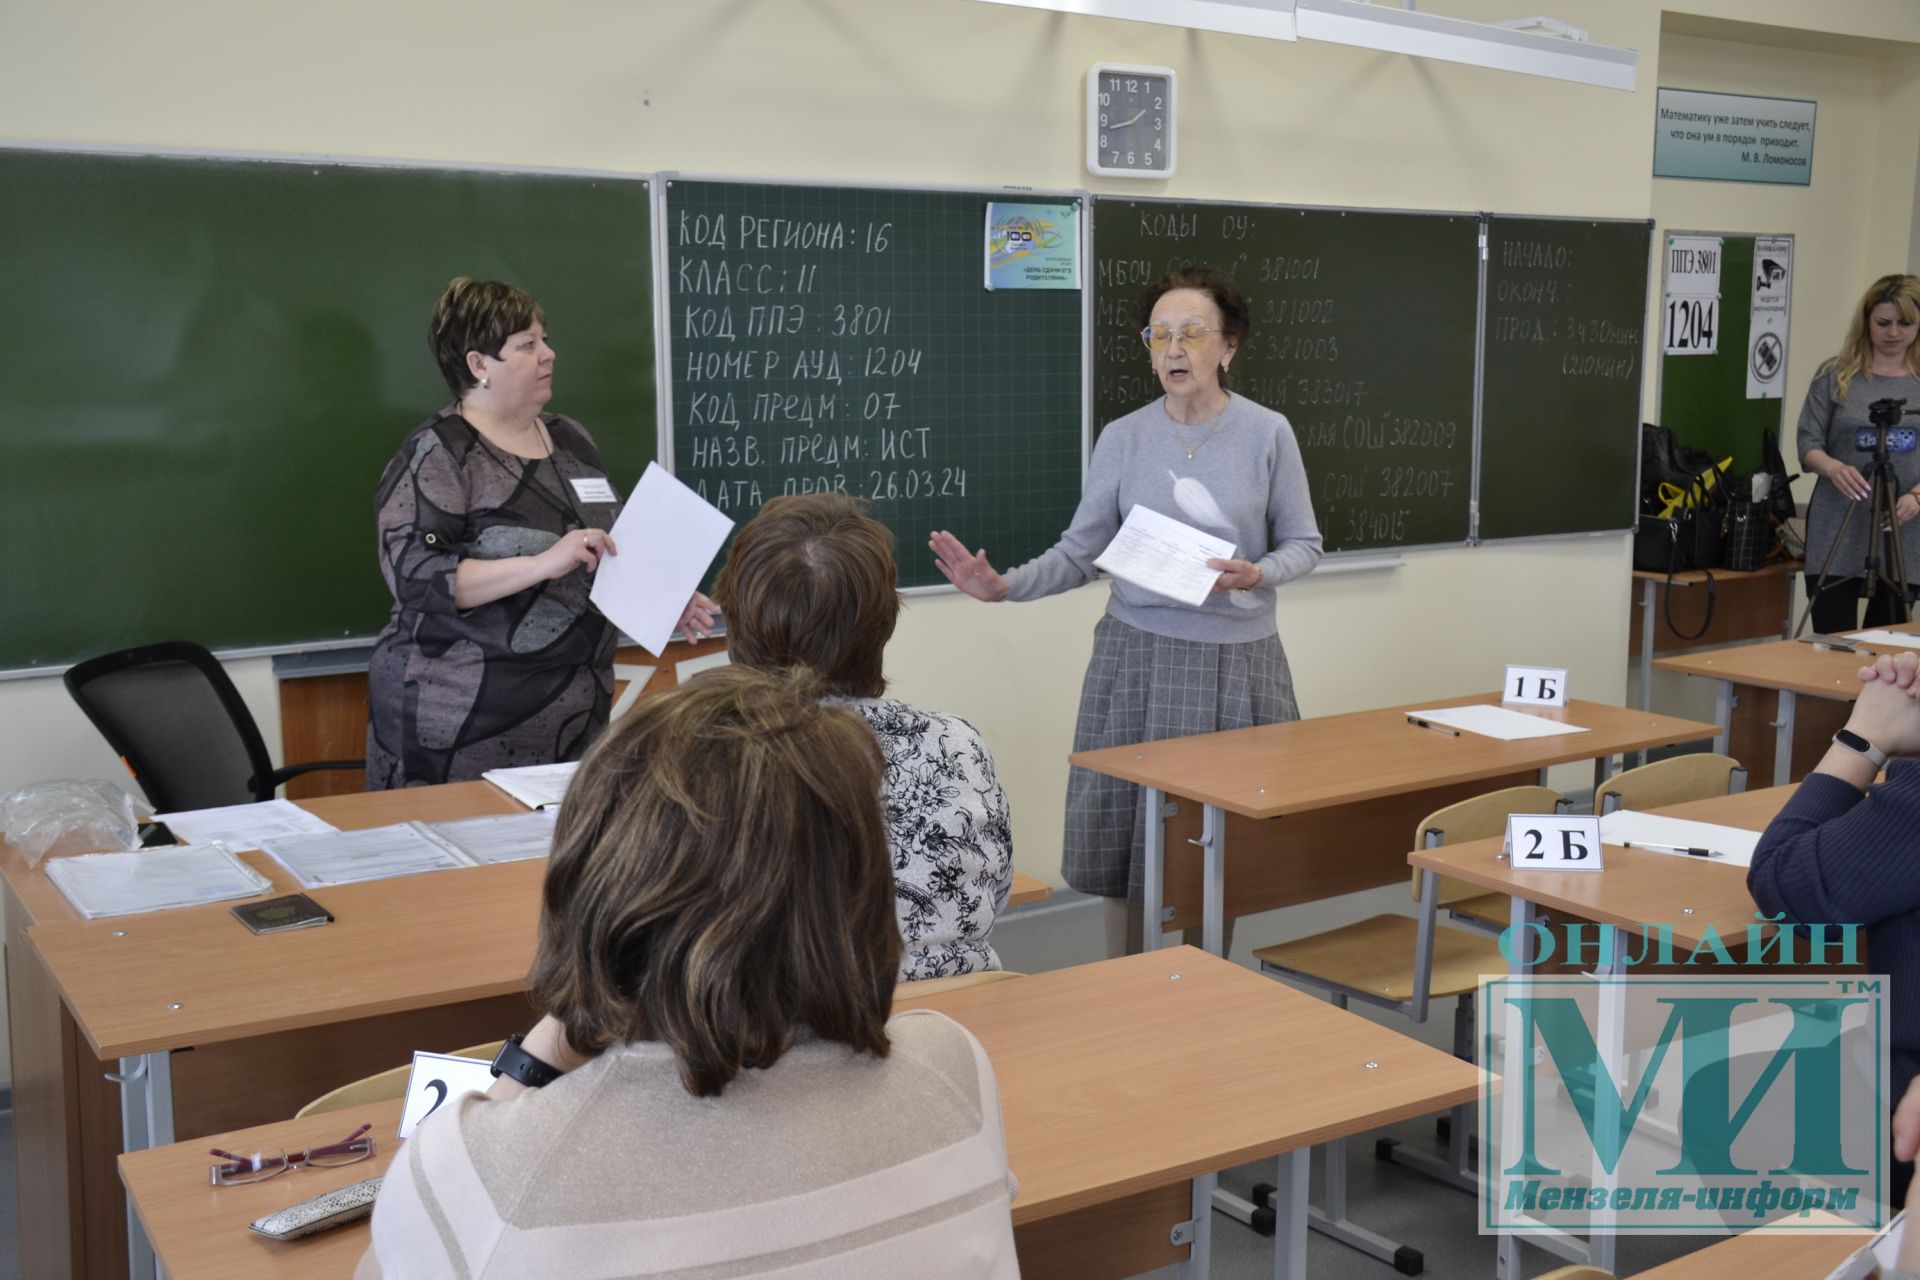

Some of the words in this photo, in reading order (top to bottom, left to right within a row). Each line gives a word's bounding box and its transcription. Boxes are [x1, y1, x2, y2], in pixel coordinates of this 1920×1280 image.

[1109, 78, 1121, 92] 11
[1125, 79, 1138, 93] 12
[1143, 81, 1151, 94] 1
[1099, 92, 1110, 106] 10
[1154, 97, 1162, 110] 2
[1100, 113, 1108, 127] 9
[1154, 117, 1162, 130] 3
[1660, 108, 1711, 125] Математику
[1713, 115, 1730, 126] уже
[1731, 115, 1754, 126] затем
[1756, 118, 1778, 129] учить
[1779, 119, 1811, 132] следует,
[1100, 134, 1108, 148] 8
[1154, 138, 1162, 151] 4
[1670, 130, 1685, 140] что
[1686, 132, 1701, 141] она
[1703, 133, 1714, 143] ум
[1716, 133, 1721, 141] в
[1722, 134, 1757, 146] порядок
[1760, 136, 1800, 149] приводит.
[1112, 151, 1120, 164] 7
[1127, 151, 1135, 165] 6
[1144, 152, 1152, 166] 5
[1741, 152, 1752, 163] М.
[1753, 153, 1761, 164] В.
[1762, 154, 1807, 167] Ломоносов
[680, 209, 726, 250] КОД
[740, 215, 856, 250] РЕГИОНА:
[866, 222, 894, 253] 16
[1139, 211, 1197, 240] КОДЫ
[680, 256, 788, 295] КЛАСС:
[797, 264, 817, 294] 11
[1098, 258, 1151, 286] МБОУ
[1259, 256, 1320, 282] 381001
[1671, 249, 1694, 273] ППЭ
[1695, 250, 1717, 274] 3801
[686, 304, 736, 342] КОД
[831, 303, 892, 336] 3801
[1262, 299, 1334, 325] 381002
[1666, 300, 1714, 349] 1204
[1266, 335, 1339, 362] 381003
[686, 350, 780, 381] НОМЕР
[865, 347, 922, 378] 1204
[1297, 377, 1368, 406] 383017
[689, 392, 741, 431] КОД
[863, 392, 901, 420] 07
[692, 436, 766, 468] НАЗВ.
[881, 427, 931, 461] ИСТ
[1390, 417, 1457, 449] 382009
[871, 466, 967, 500] 26.03.24
[1379, 466, 1455, 498] 382007
[1345, 509, 1411, 542] 384015
[1515, 676, 1525, 698] 1
[1536, 677, 1557, 700] Б
[1523, 829, 1545, 860] 2
[1557, 829, 1589, 861] Б
